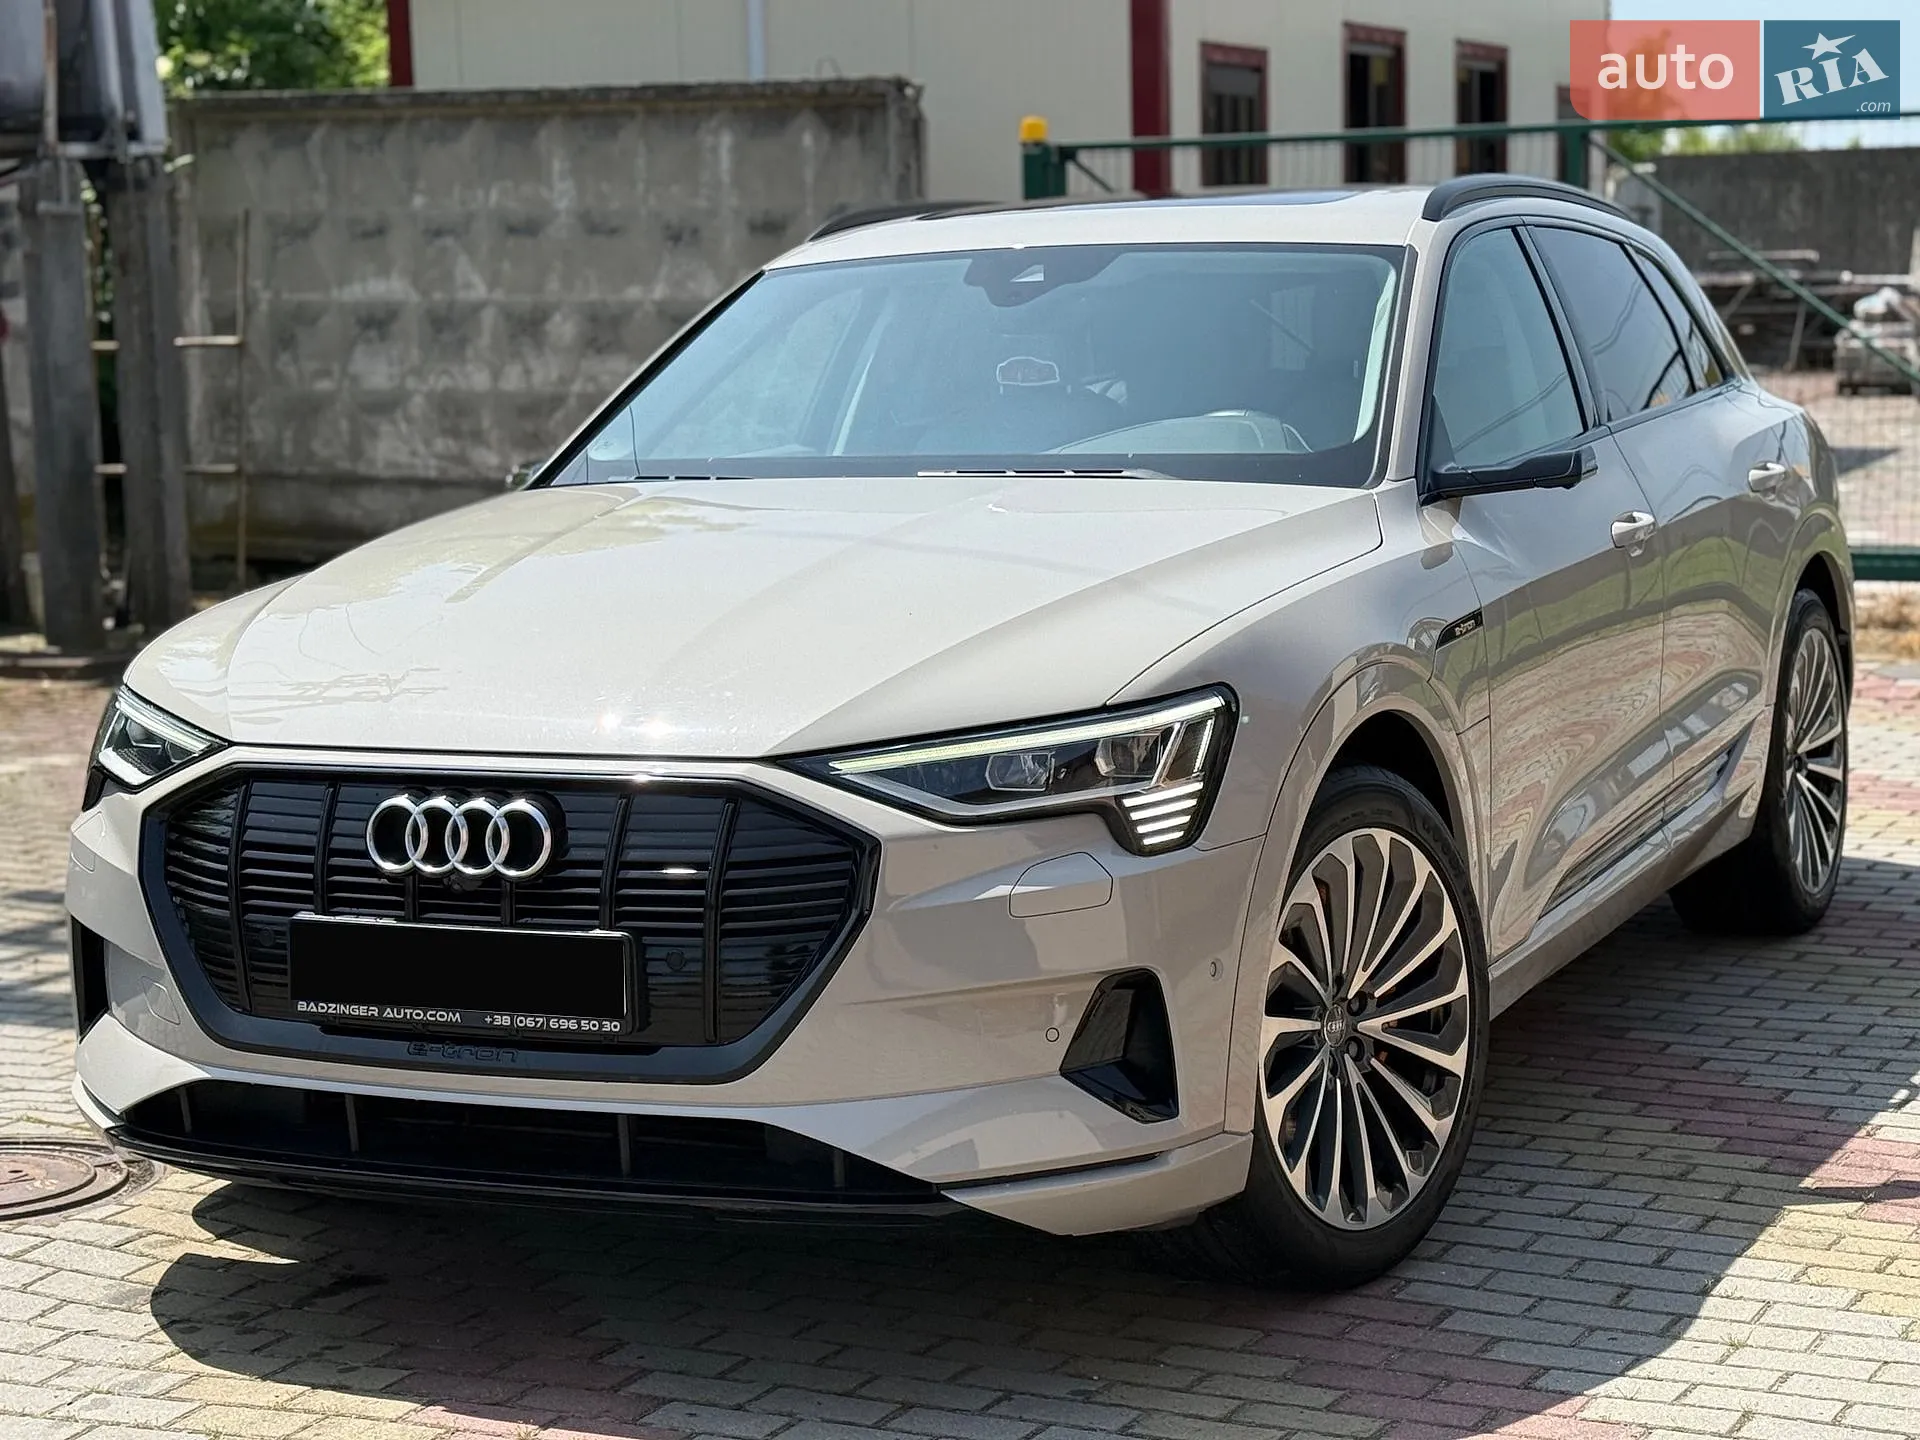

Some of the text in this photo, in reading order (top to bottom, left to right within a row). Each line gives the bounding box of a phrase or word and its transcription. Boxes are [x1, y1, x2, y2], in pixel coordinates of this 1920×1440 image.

[297, 1001, 621, 1032] BADZINGER AUTO.COM +38 (067) 696 50 30
[407, 1041, 519, 1063] e-tron
